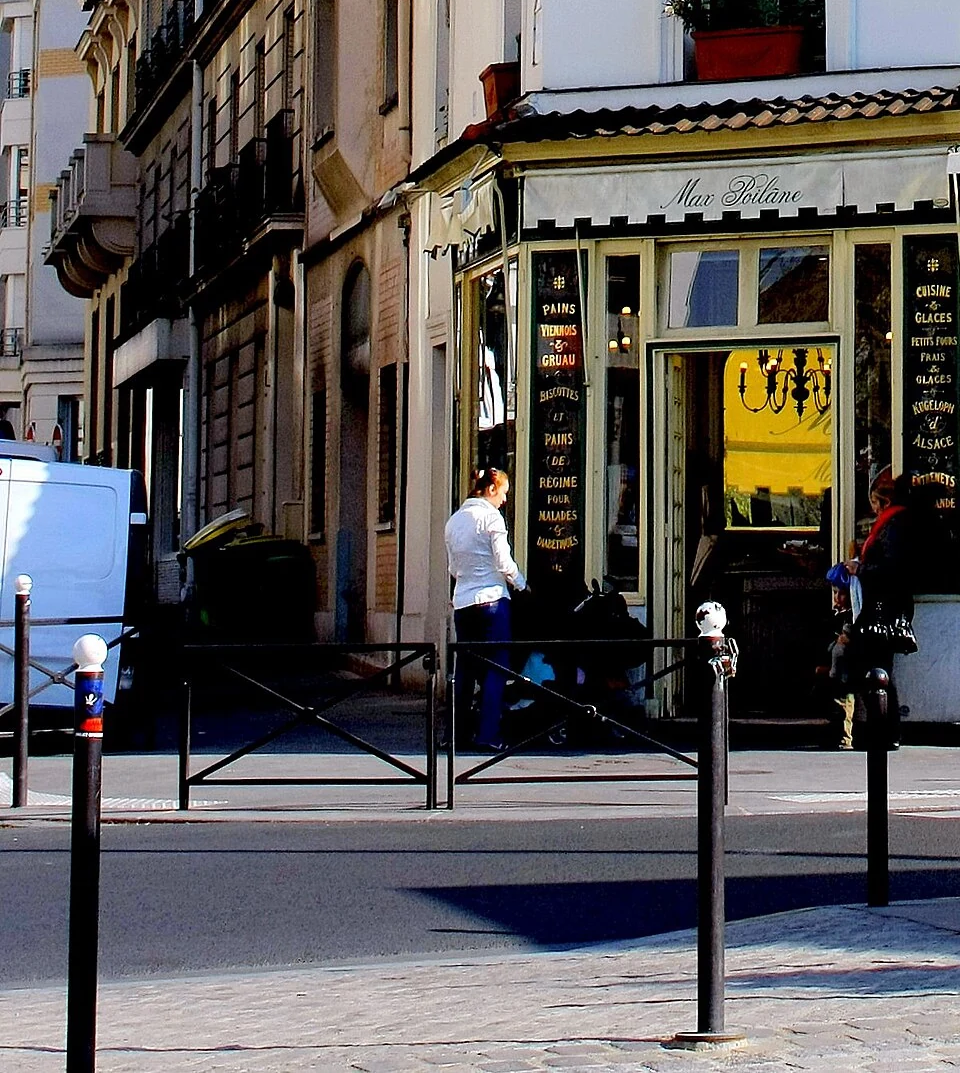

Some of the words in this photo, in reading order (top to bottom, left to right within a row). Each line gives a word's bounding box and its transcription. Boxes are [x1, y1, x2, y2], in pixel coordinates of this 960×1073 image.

[660, 177, 715, 209] Max
[721, 173, 804, 207] Poilâne
[916, 285, 952, 298] CUISINE
[542, 302, 576, 316] PAINS
[915, 311, 953, 324] GLACES
[540, 324, 577, 337] VIENNOIS
[911, 336, 934, 347] PETITS
[541, 354, 576, 367] GRUAU
[920, 352, 946, 362] FRAIS
[916, 374, 952, 385] GLACES
[539, 386, 579, 403] BISCOTTES
[544, 432, 574, 446] PAINS
[912, 433, 955, 450] ALSACE
[551, 455, 566, 466] DE
[547, 494, 571, 505] POUR
